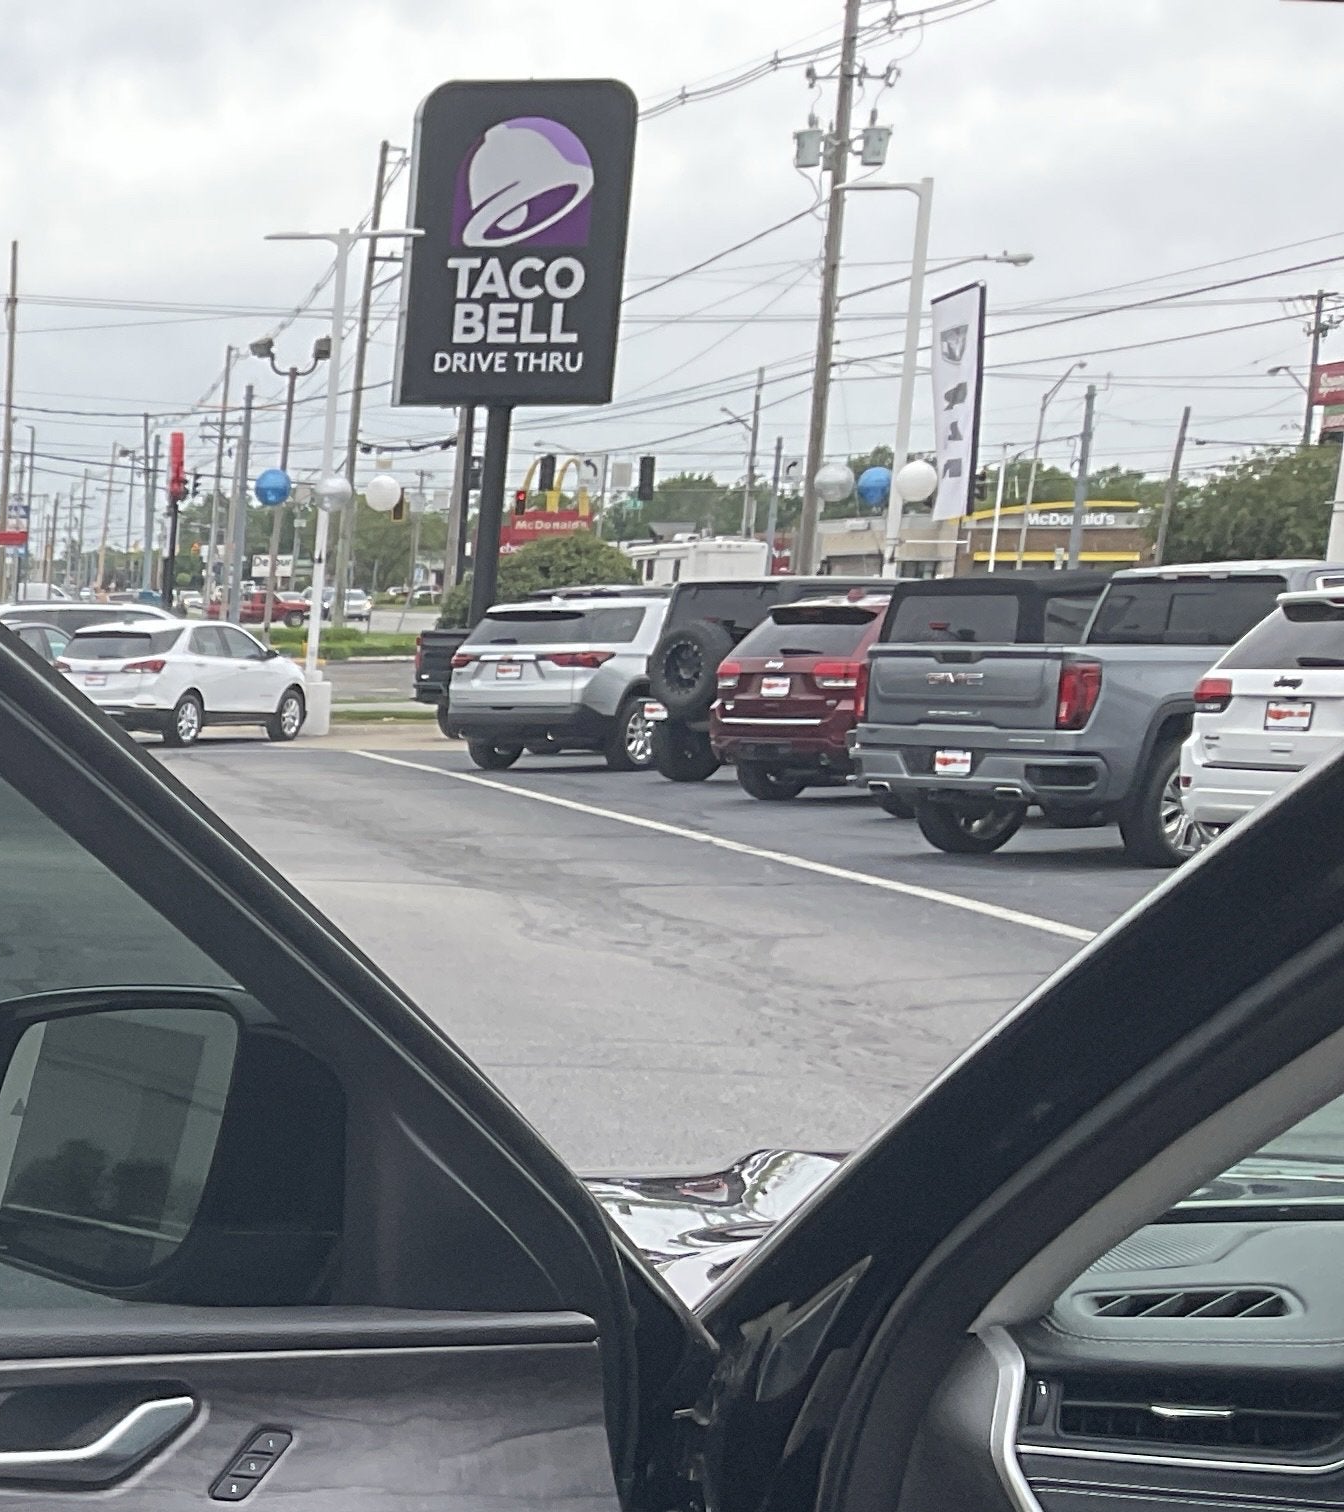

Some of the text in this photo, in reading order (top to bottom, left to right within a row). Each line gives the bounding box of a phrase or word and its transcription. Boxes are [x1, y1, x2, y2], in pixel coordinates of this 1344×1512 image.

[446, 256, 586, 299] TACO
[452, 303, 579, 344] BELL
[433, 351, 584, 373] DRIVE THRU
